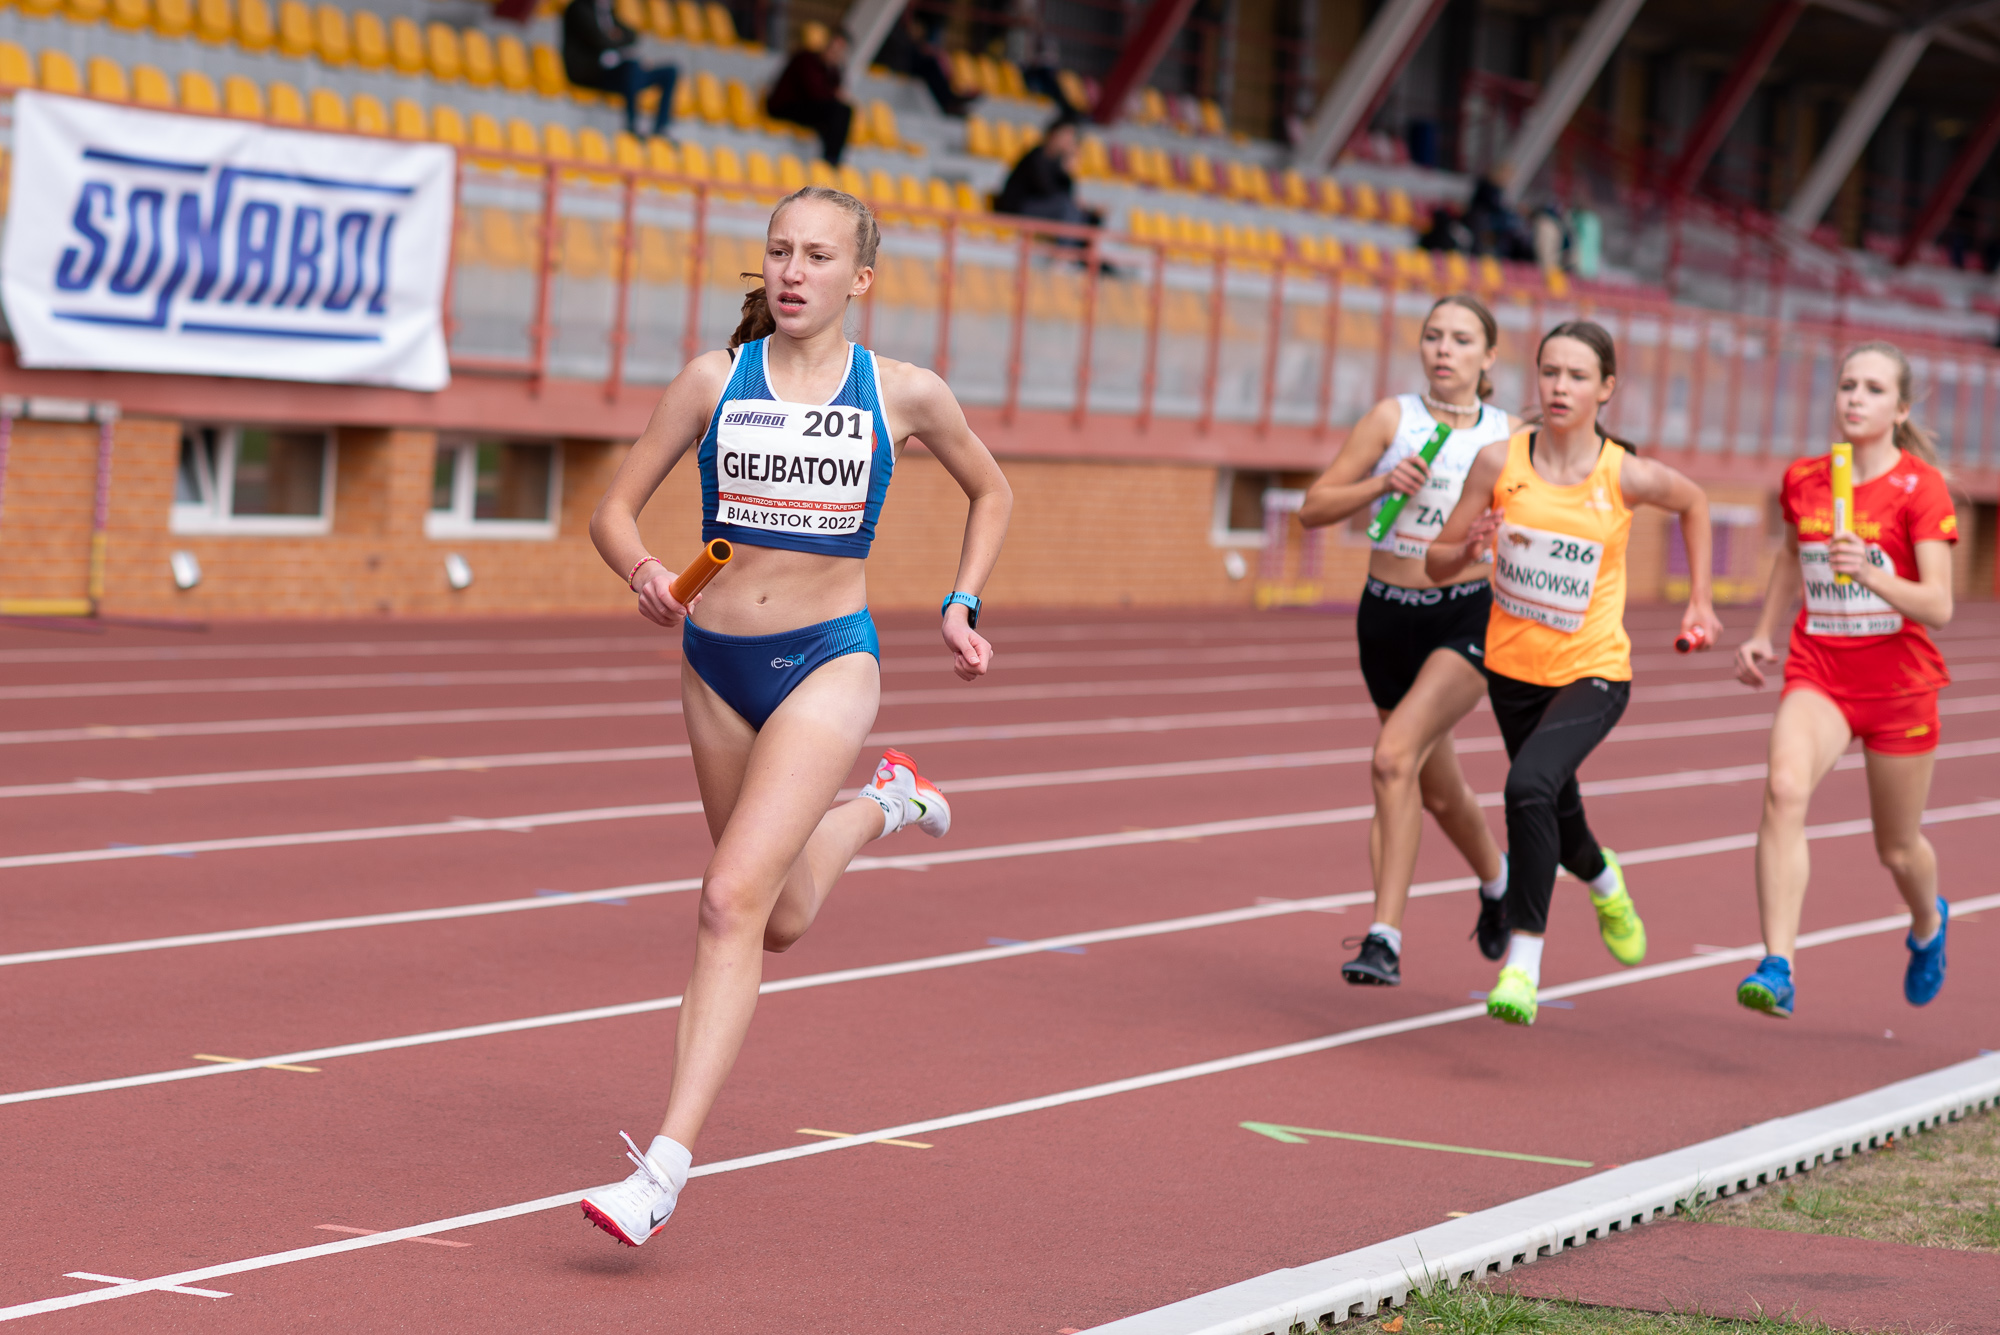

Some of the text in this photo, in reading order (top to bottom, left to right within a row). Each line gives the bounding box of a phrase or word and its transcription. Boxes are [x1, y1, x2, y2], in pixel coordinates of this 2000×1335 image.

[51, 166, 399, 329] SONAROL
[723, 411, 788, 429] SONAROL
[802, 410, 863, 440] 201
[723, 451, 866, 487] GIEJBATOW
[723, 493, 741, 501] PZLA
[741, 496, 788, 507] MISTRZOSTWA
[788, 501, 813, 509] POLSKI
[822, 503, 863, 511] SZTAFETACH
[727, 506, 856, 530] BIAŁYSTOK 2022
[1549, 539, 1595, 564] 286
[1497, 553, 1590, 599] FRANKOWSKA
[1384, 587, 1443, 607] PRO
[1868, 619, 1896, 631] 2022
